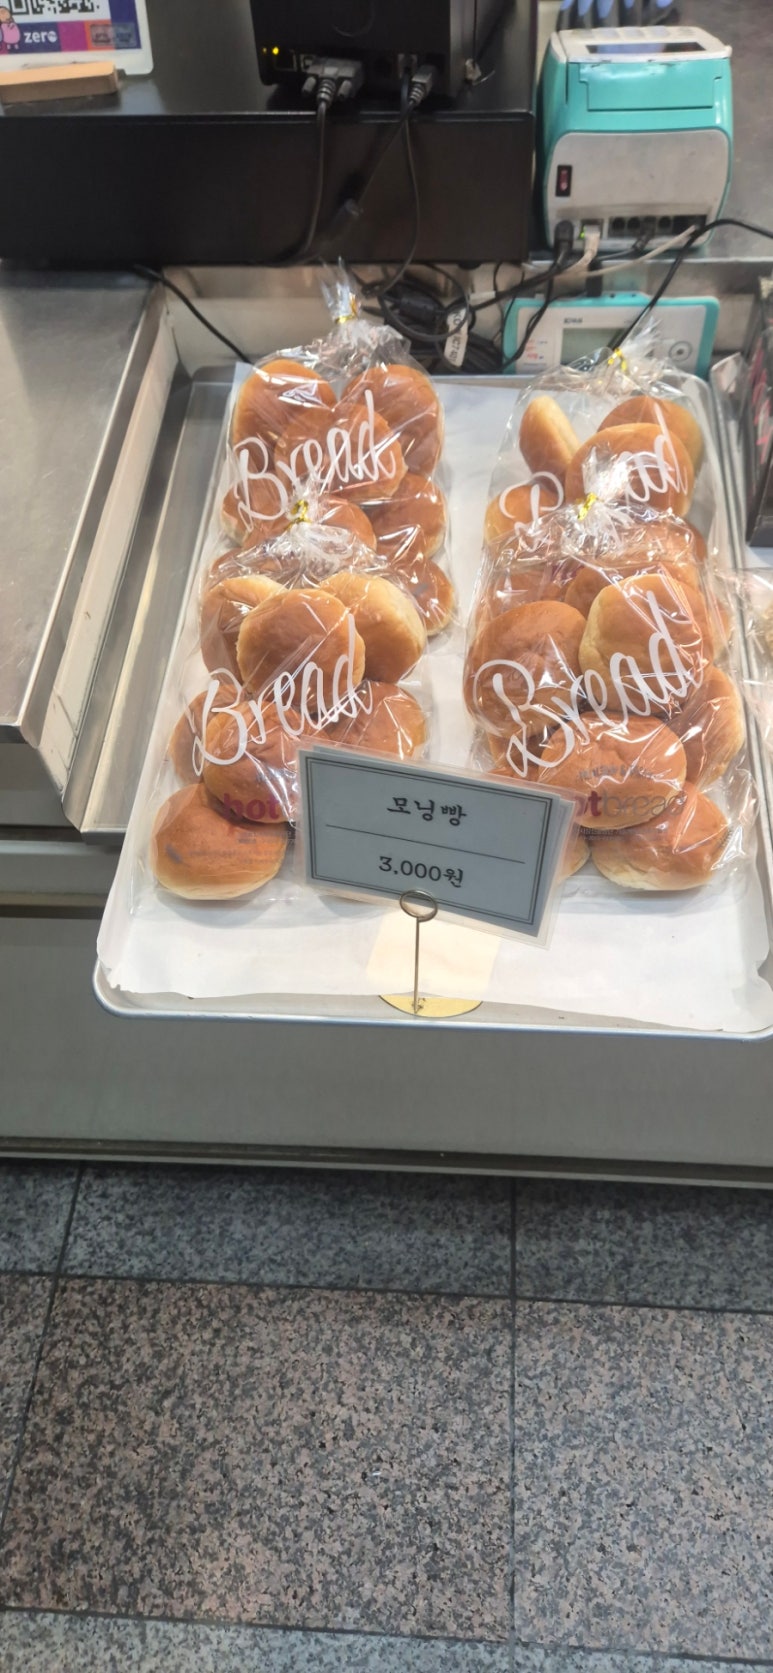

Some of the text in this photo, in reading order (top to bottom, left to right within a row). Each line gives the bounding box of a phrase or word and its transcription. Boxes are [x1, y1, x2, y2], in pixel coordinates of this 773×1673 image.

[23, 30, 58, 43] zero
[233, 389, 396, 532] Bread
[184, 613, 373, 776] Bread
[473, 591, 703, 777] Bread
[387, 797, 466, 826] 모닝빵
